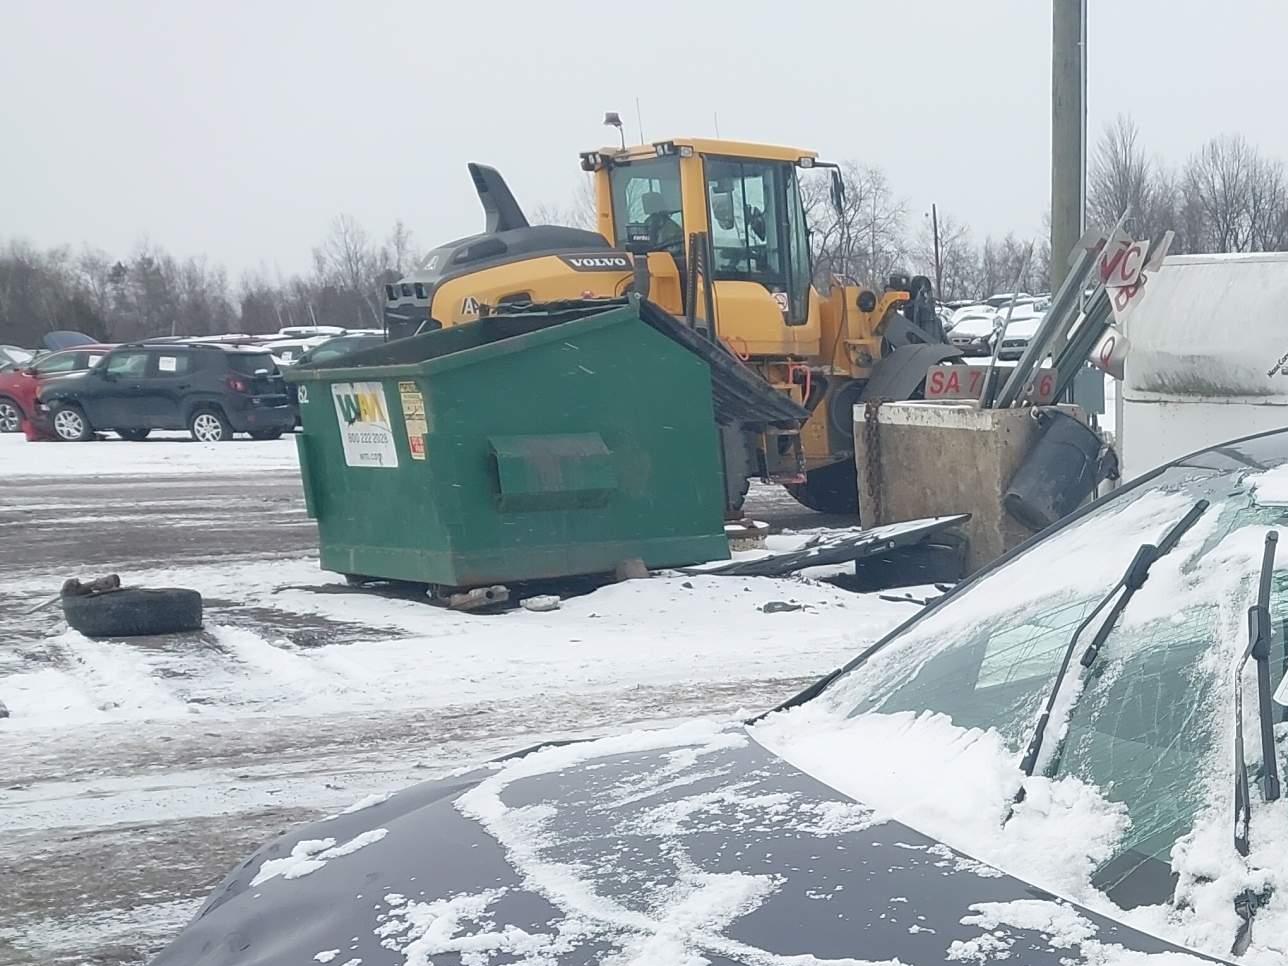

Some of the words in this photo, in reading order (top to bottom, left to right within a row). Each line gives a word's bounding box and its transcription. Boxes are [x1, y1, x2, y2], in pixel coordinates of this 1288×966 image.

[570, 257, 626, 267] VOLVO
[1101, 336, 1116, 368] Q
[929, 371, 960, 394] SA
